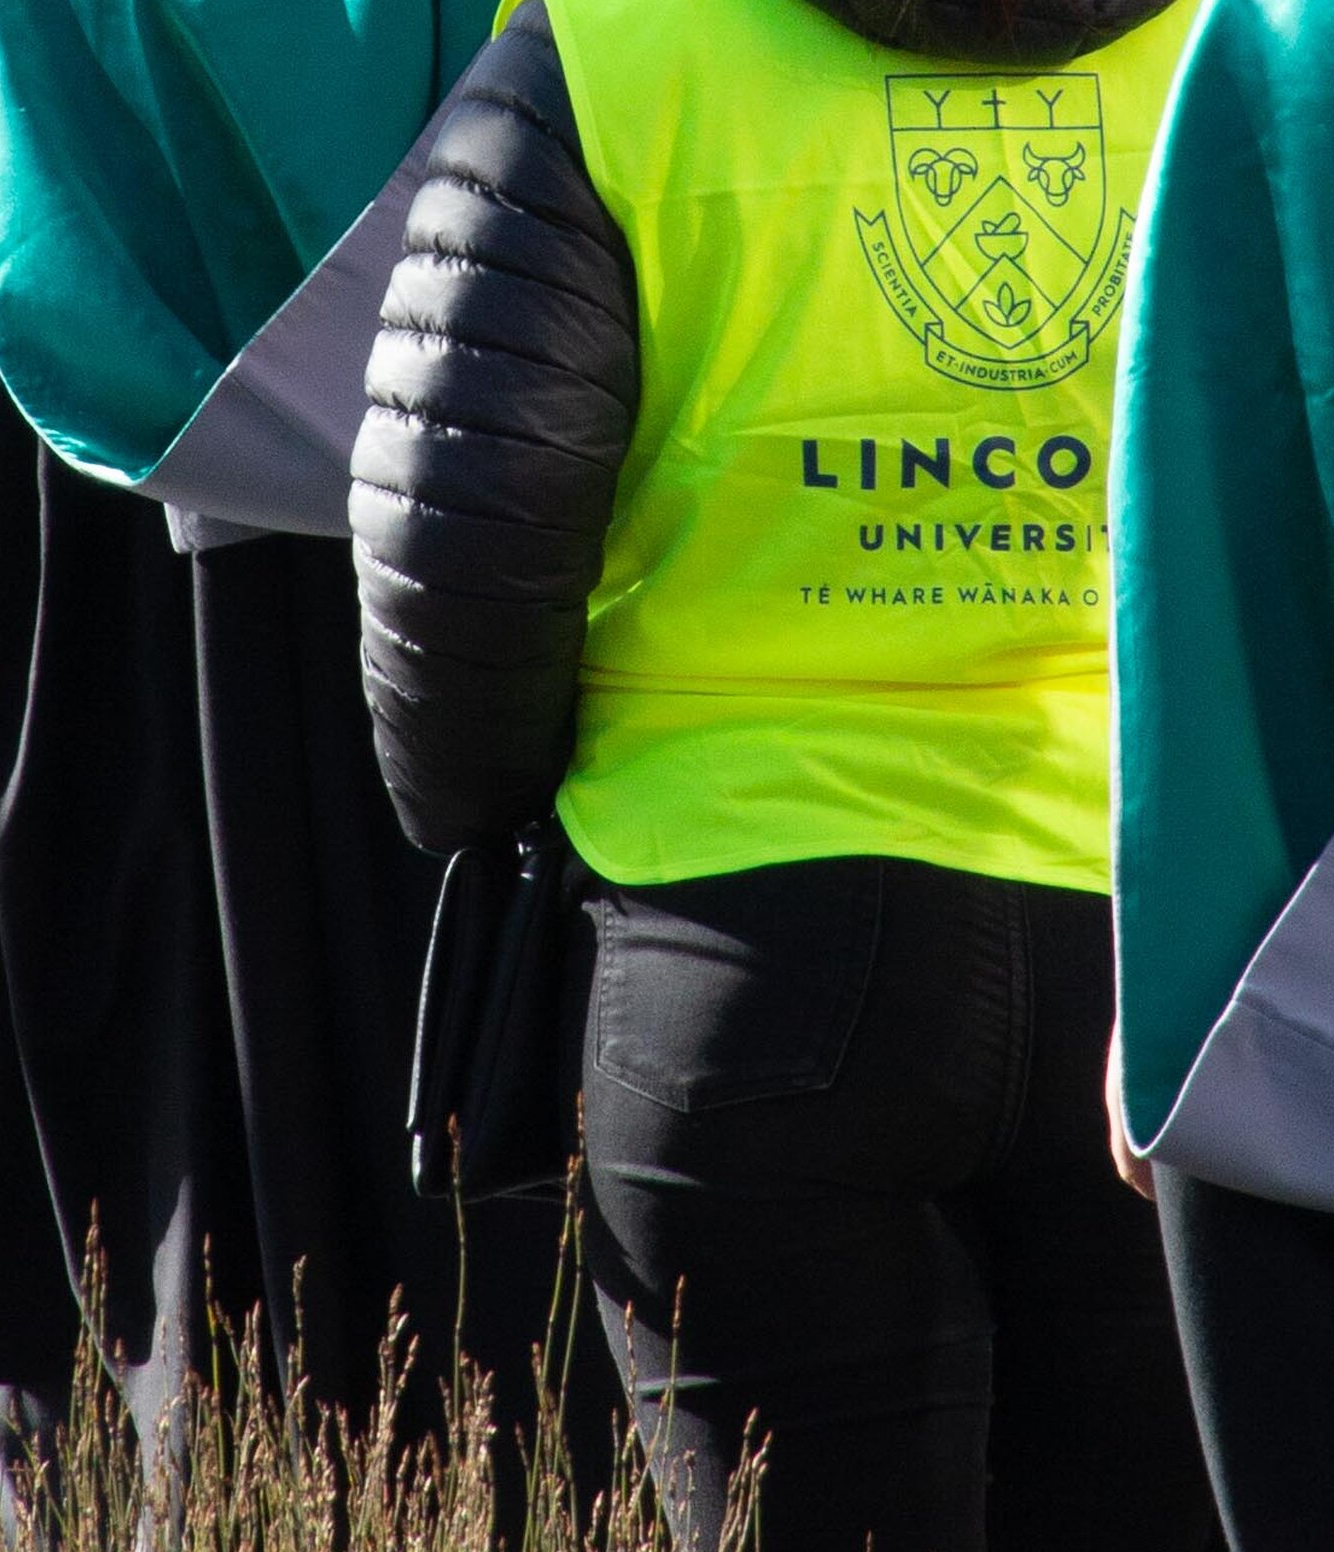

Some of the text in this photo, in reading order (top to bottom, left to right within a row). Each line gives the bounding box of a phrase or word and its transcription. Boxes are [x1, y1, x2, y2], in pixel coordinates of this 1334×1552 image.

[871, 240, 919, 319] SCIENTIA
[801, 435, 1092, 490] LINCO
[859, 523, 1109, 552] UNIVERSI
[846, 586, 945, 605] WHARE
